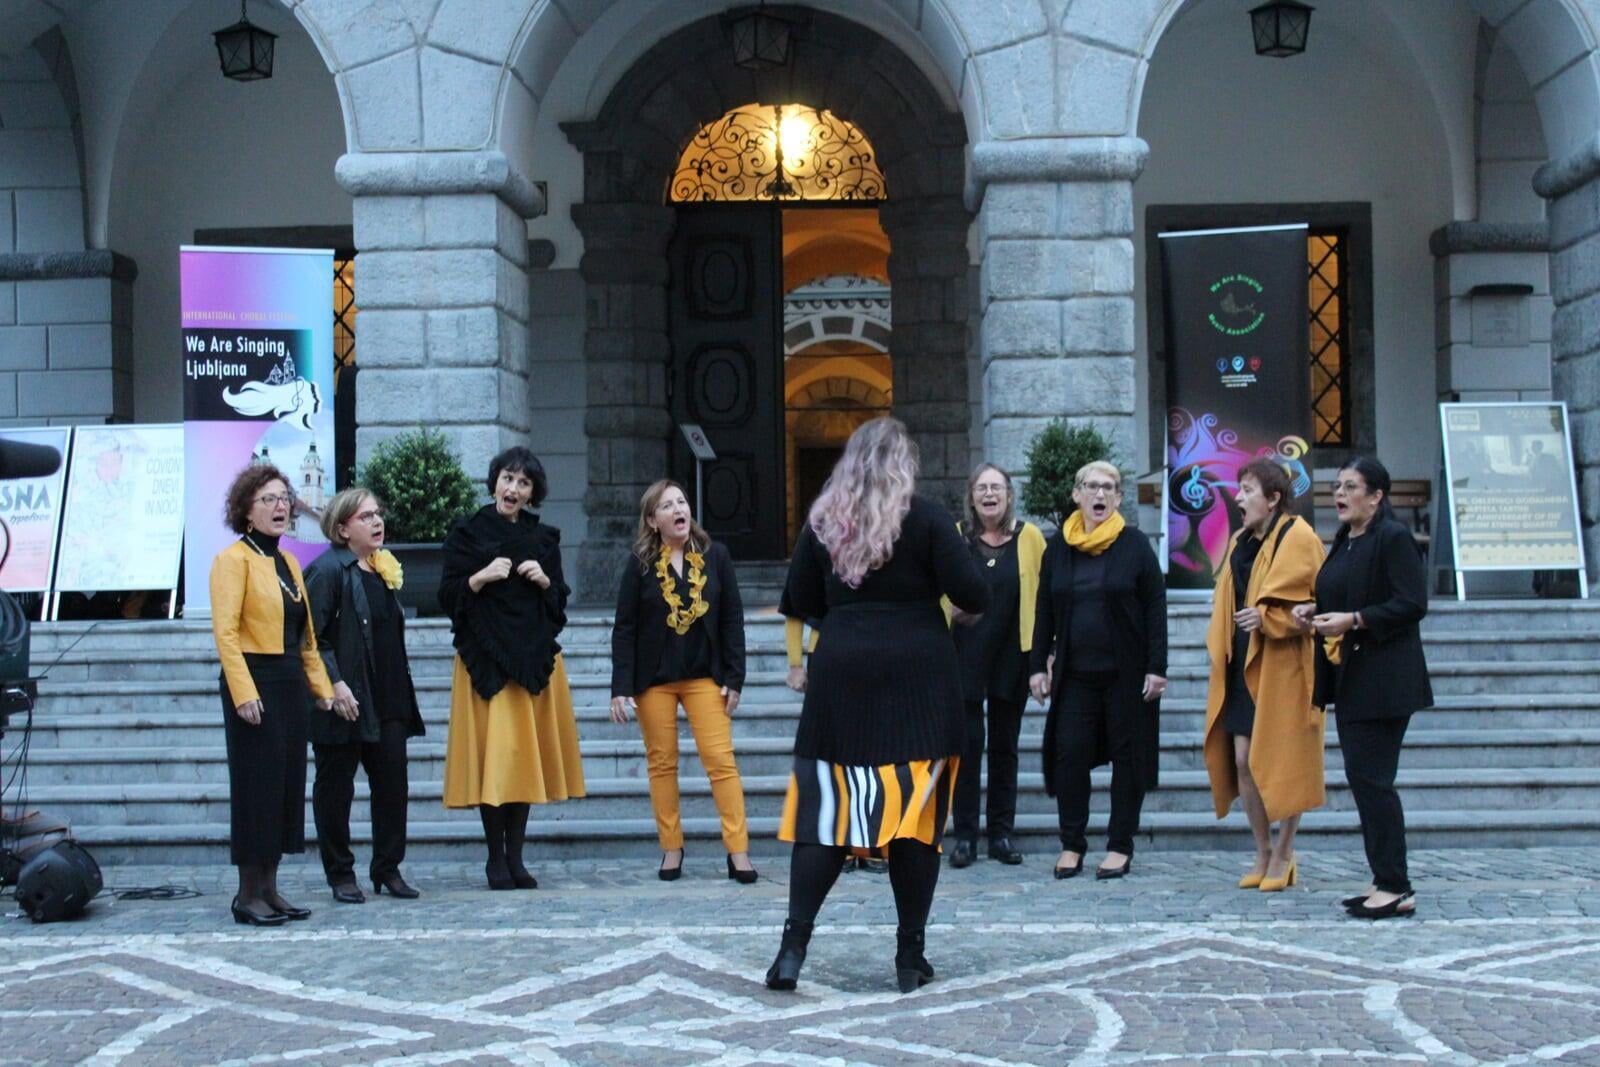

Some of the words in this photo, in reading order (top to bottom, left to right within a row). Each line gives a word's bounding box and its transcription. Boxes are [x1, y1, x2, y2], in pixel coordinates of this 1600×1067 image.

[183, 311, 236, 321] INTERNATIONAL
[185, 335, 206, 353] We
[210, 335, 233, 353] Are
[236, 336, 285, 357] Singing
[186, 359, 247, 381] Ljubljana
[9, 512, 51, 526] typeface
